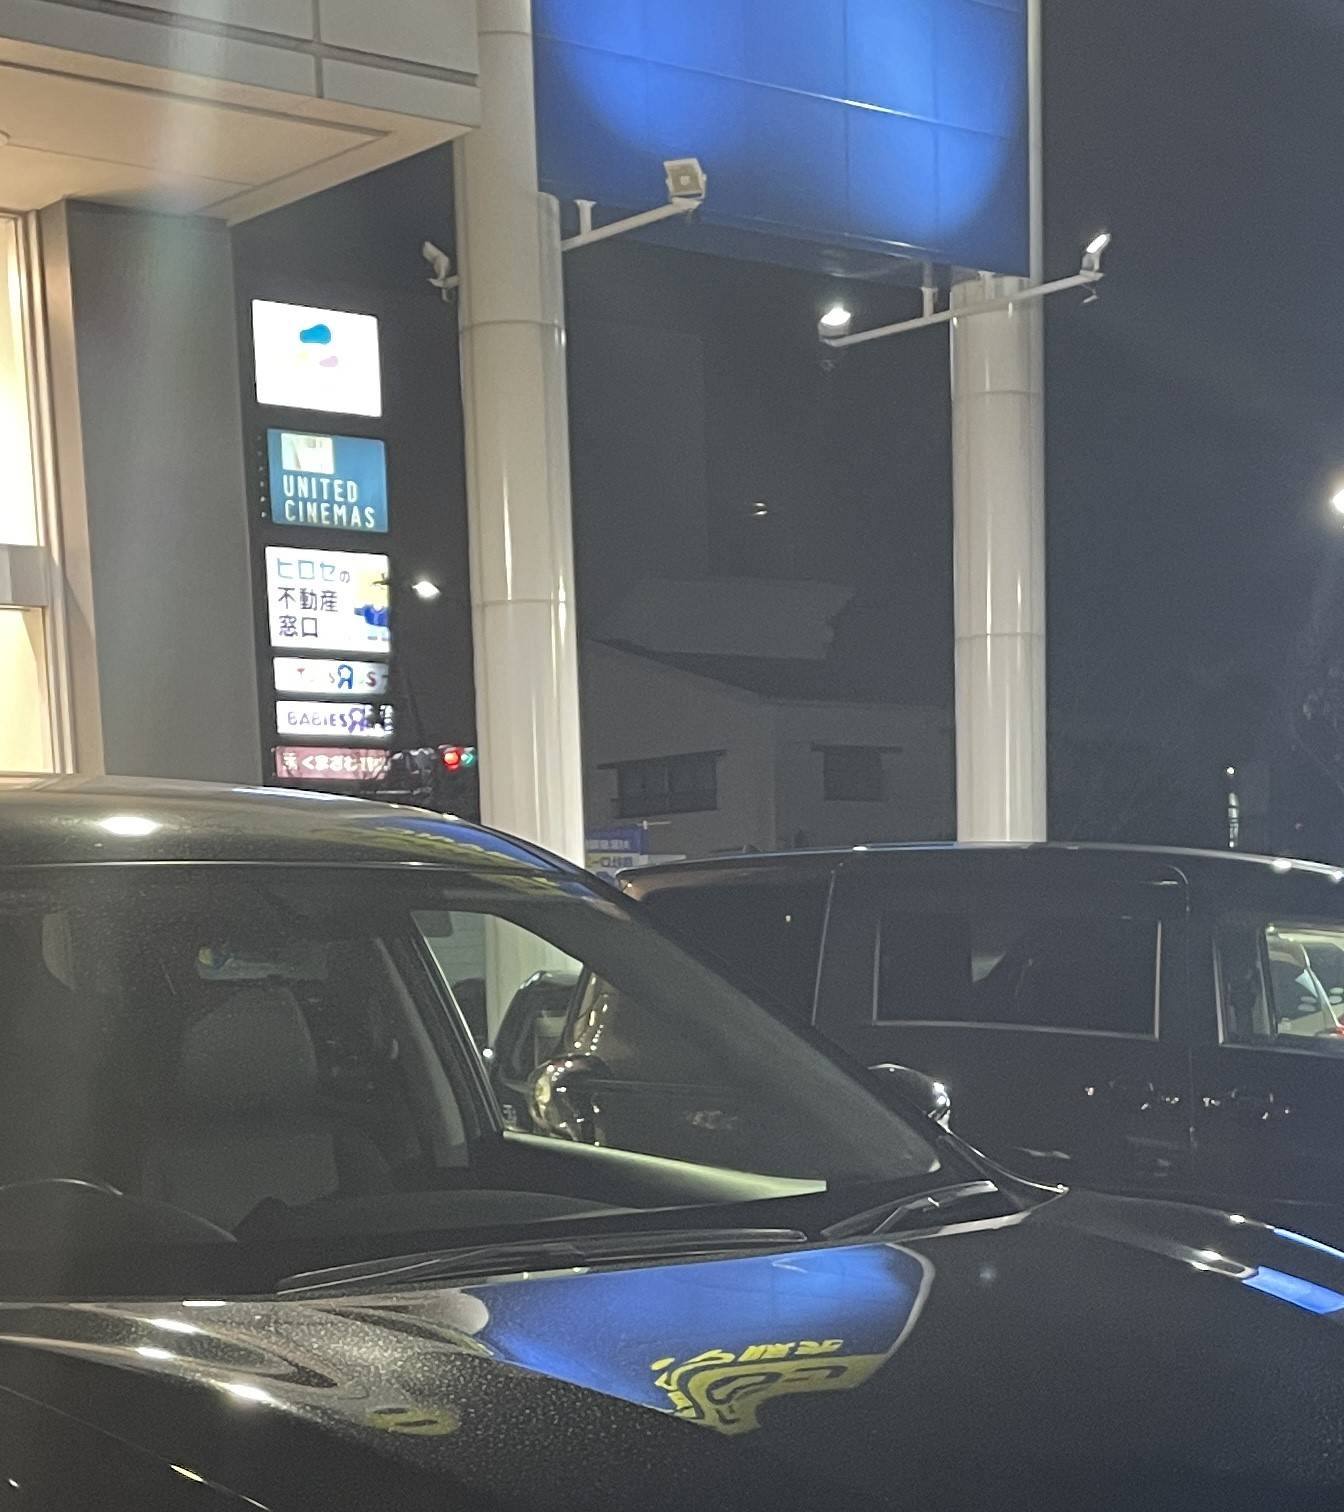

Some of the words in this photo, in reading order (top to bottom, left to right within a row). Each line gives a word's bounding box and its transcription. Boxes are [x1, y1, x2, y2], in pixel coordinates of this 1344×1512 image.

[283, 475, 357, 503] UNITED
[285, 500, 375, 528] CINEMAS
[277, 558, 350, 583] ヒロセの
[277, 587, 338, 612] 不動産
[279, 615, 318, 637] 窓口
